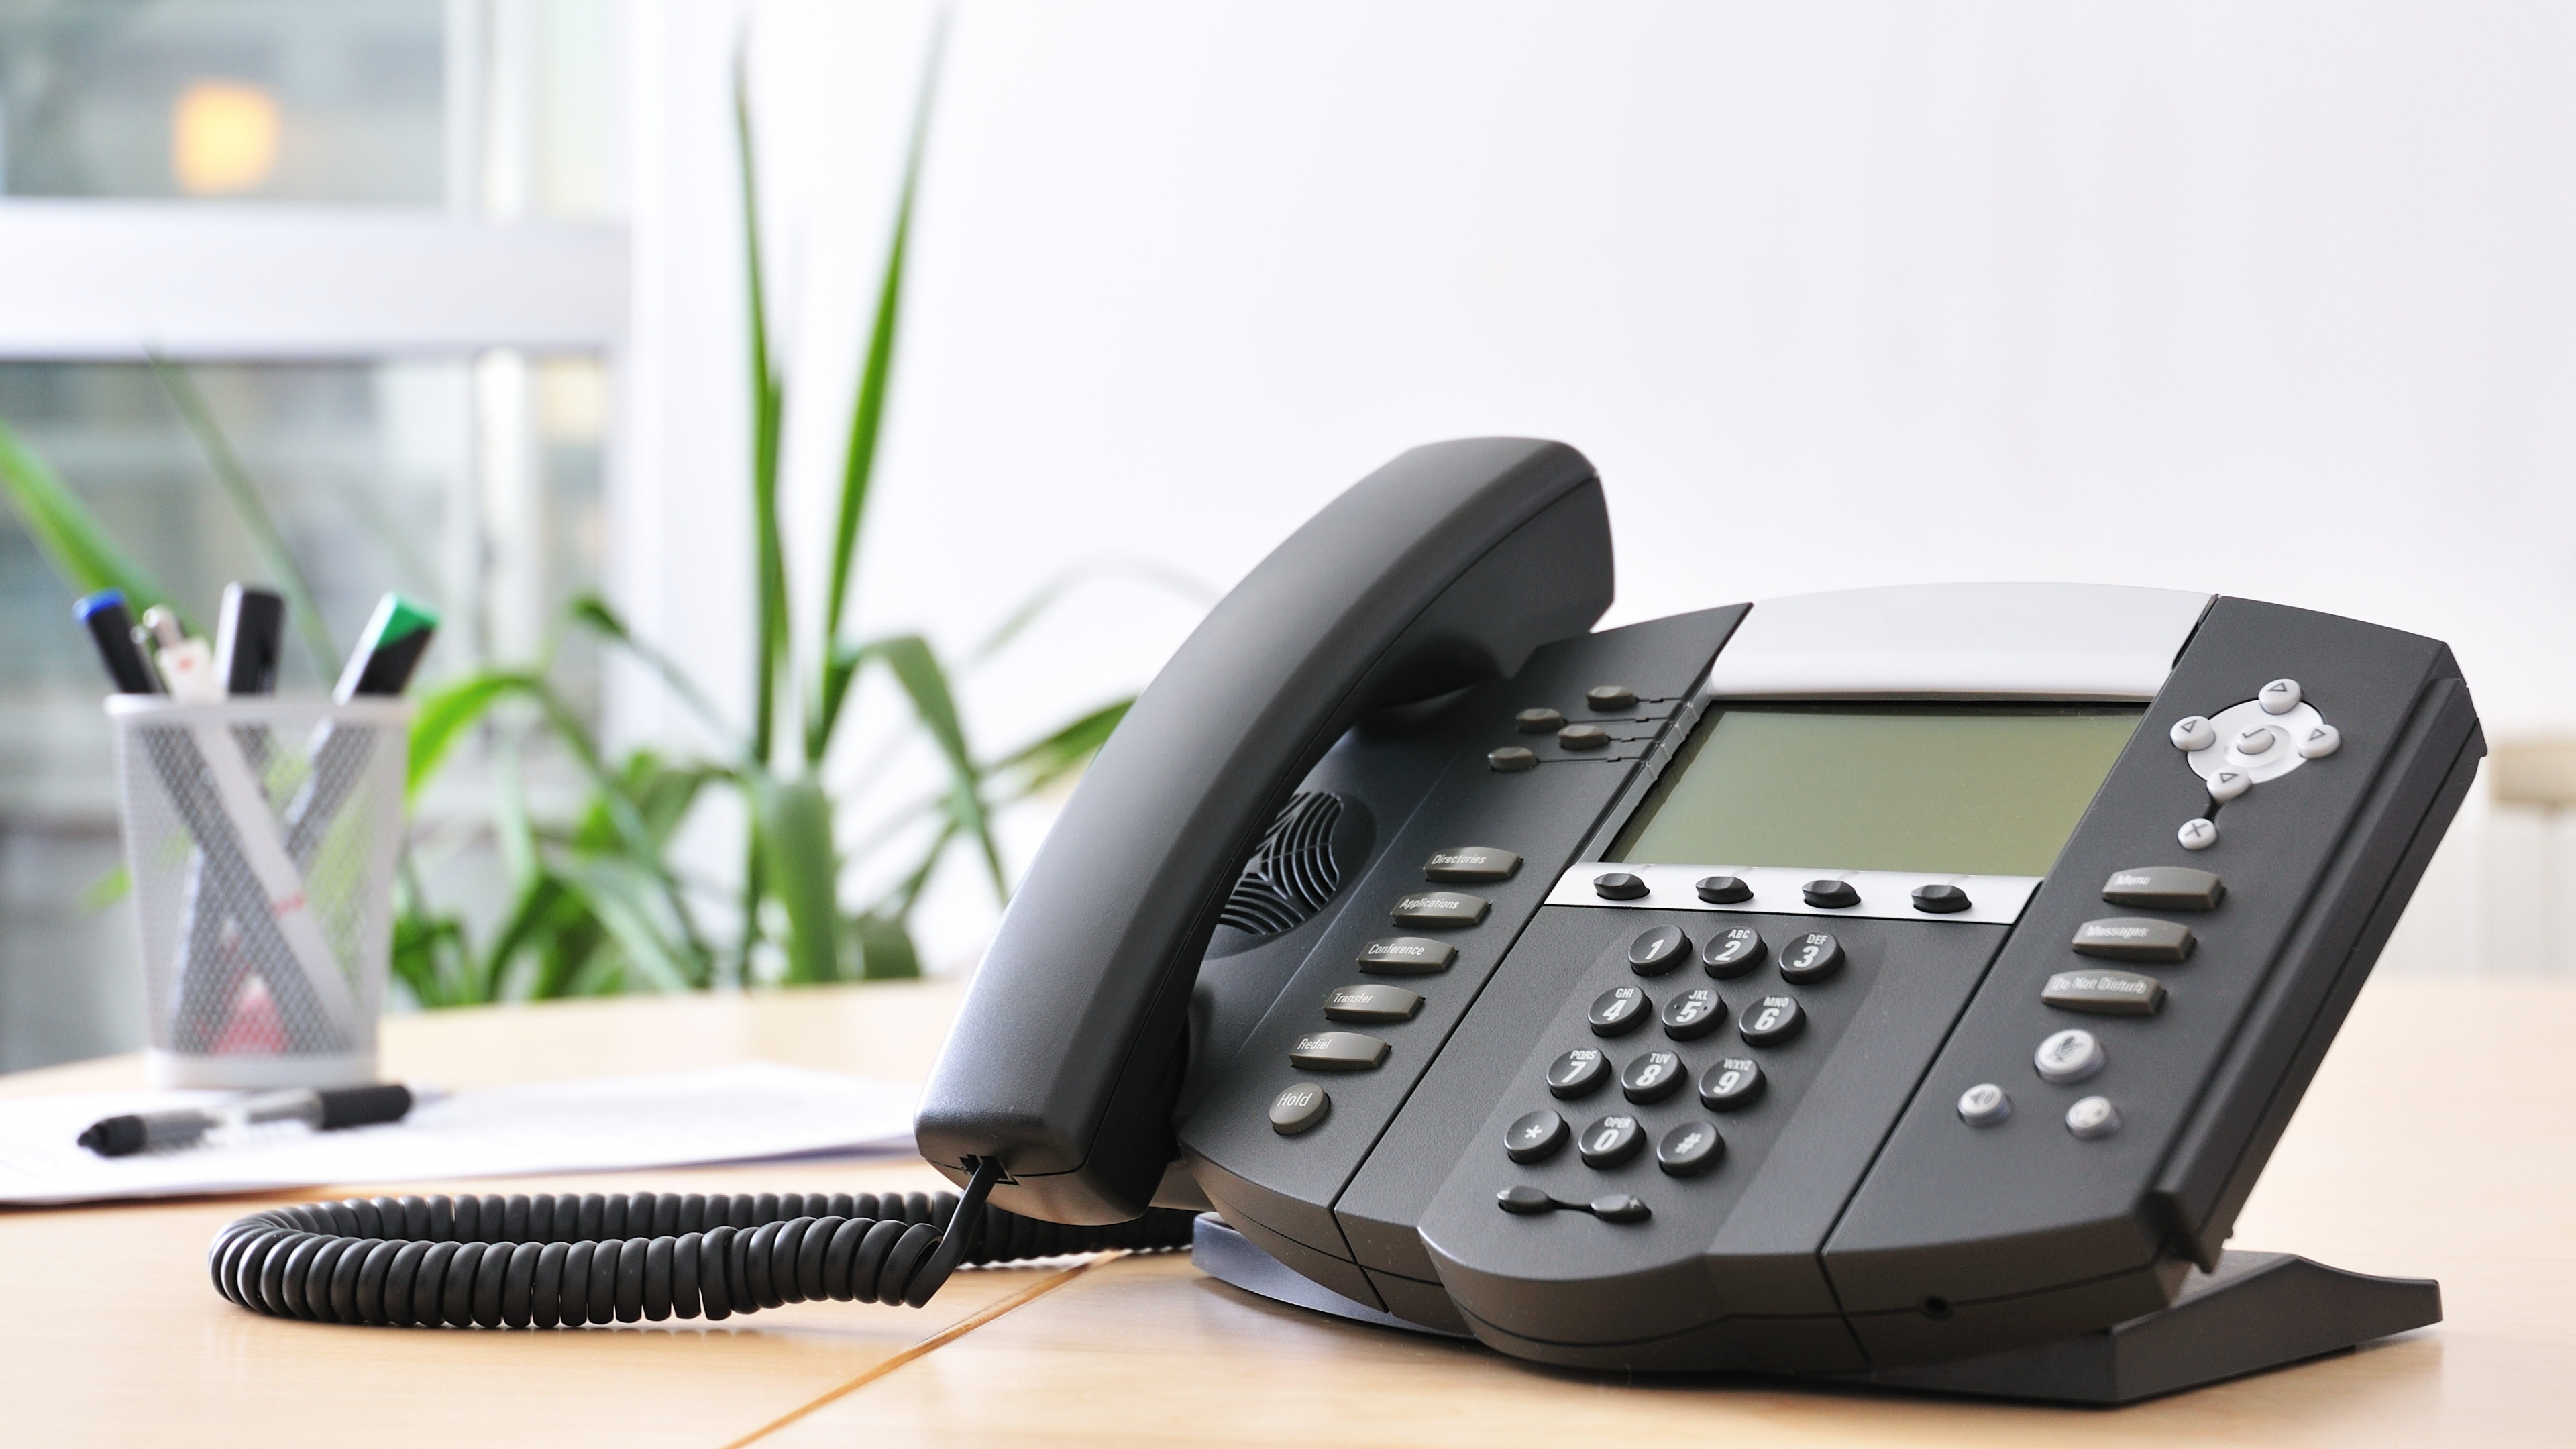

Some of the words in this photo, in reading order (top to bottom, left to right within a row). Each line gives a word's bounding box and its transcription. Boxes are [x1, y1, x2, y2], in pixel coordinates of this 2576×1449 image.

[1432, 853, 1487, 864] Directories
[2113, 874, 2151, 886] Menu
[1399, 898, 1459, 910] Applications
[1728, 929, 1750, 939] ABC
[2084, 925, 2149, 939] Messages
[1806, 934, 1827, 945] DEF
[1368, 943, 1425, 955] Conference
[1645, 939, 1664, 960] 1
[1715, 941, 1741, 961] 2
[1793, 946, 1819, 967] 3
[2051, 977, 2071, 990] Do
[2096, 977, 2147, 994] Disturb
[1333, 993, 1374, 1004] Transfer
[1615, 988, 1634, 998] GHI
[1688, 990, 1708, 1000] JKL
[1763, 996, 1789, 1008] MNO
[1602, 999, 1627, 1021] 4
[1676, 1000, 1702, 1022] 5
[1754, 1007, 1780, 1031] 6
[1297, 1038, 1332, 1050] Redial
[1570, 1050, 1597, 1061] PQRS
[1650, 1053, 1671, 1064] TUV
[1723, 1058, 1752, 1071] WXYZ
[1561, 1061, 1587, 1083] 7
[1635, 1064, 1662, 1087] 8
[1713, 1071, 1741, 1094] 9
[1277, 1093, 1312, 1106] Hold
[1604, 1116, 1631, 1128] OPER
[1593, 1129, 1619, 1152] 0
